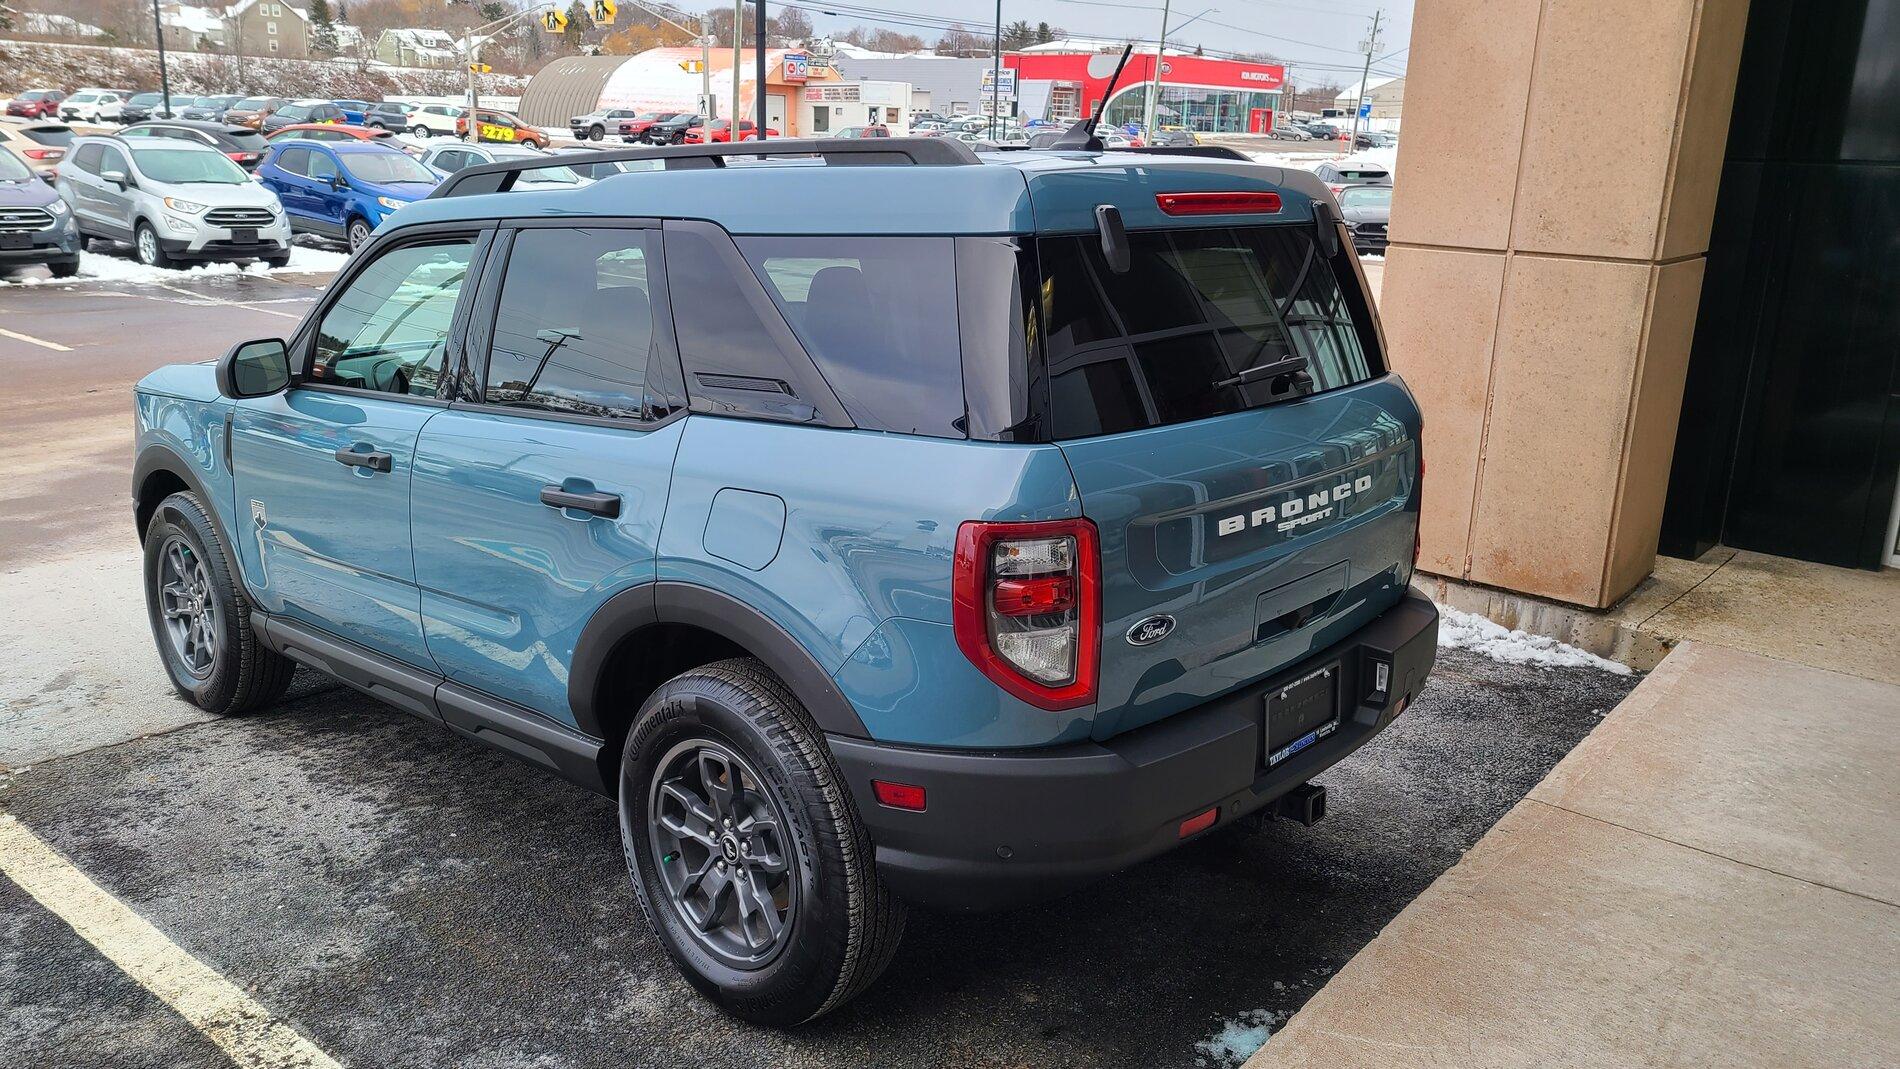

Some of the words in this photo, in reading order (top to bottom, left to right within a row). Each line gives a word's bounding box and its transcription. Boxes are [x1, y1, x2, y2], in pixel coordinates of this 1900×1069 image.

[1218, 475, 1372, 537] BRONCO
[1277, 507, 1333, 532] SPORT
[1139, 620, 1167, 641] Ford
